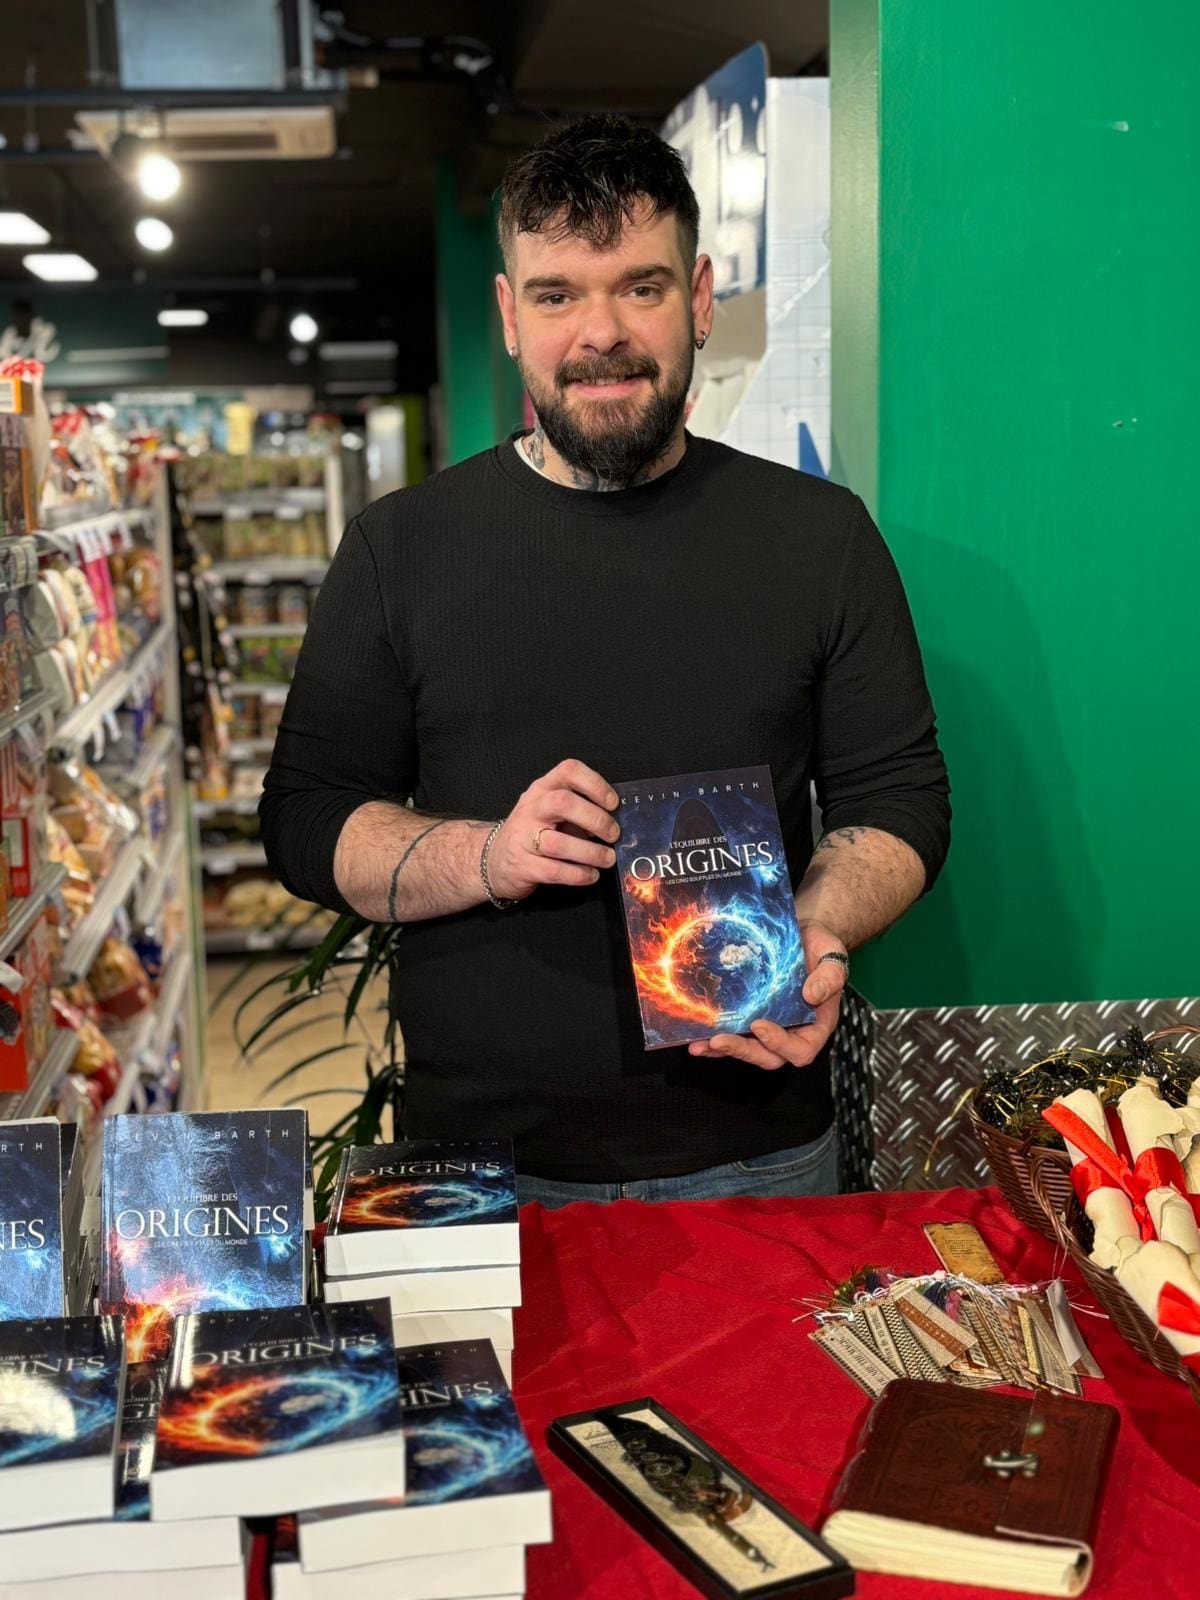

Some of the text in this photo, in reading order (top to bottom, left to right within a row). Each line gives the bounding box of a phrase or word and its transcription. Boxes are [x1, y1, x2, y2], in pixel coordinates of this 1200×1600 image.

[621, 781, 760, 805] KEVIN BARTH
[713, 835, 728, 844] DES
[631, 841, 773, 881] ORIGINES
[213, 1129, 290, 1141] BARTH
[0, 1142, 43, 1153] RTH
[350, 1161, 501, 1178] ORIGINES
[220, 1192, 239, 1202] DES
[115, 1204, 290, 1241] ORIGINES
[225, 1238, 249, 1246] MONDE
[192, 1333, 377, 1367] ORIGINES
